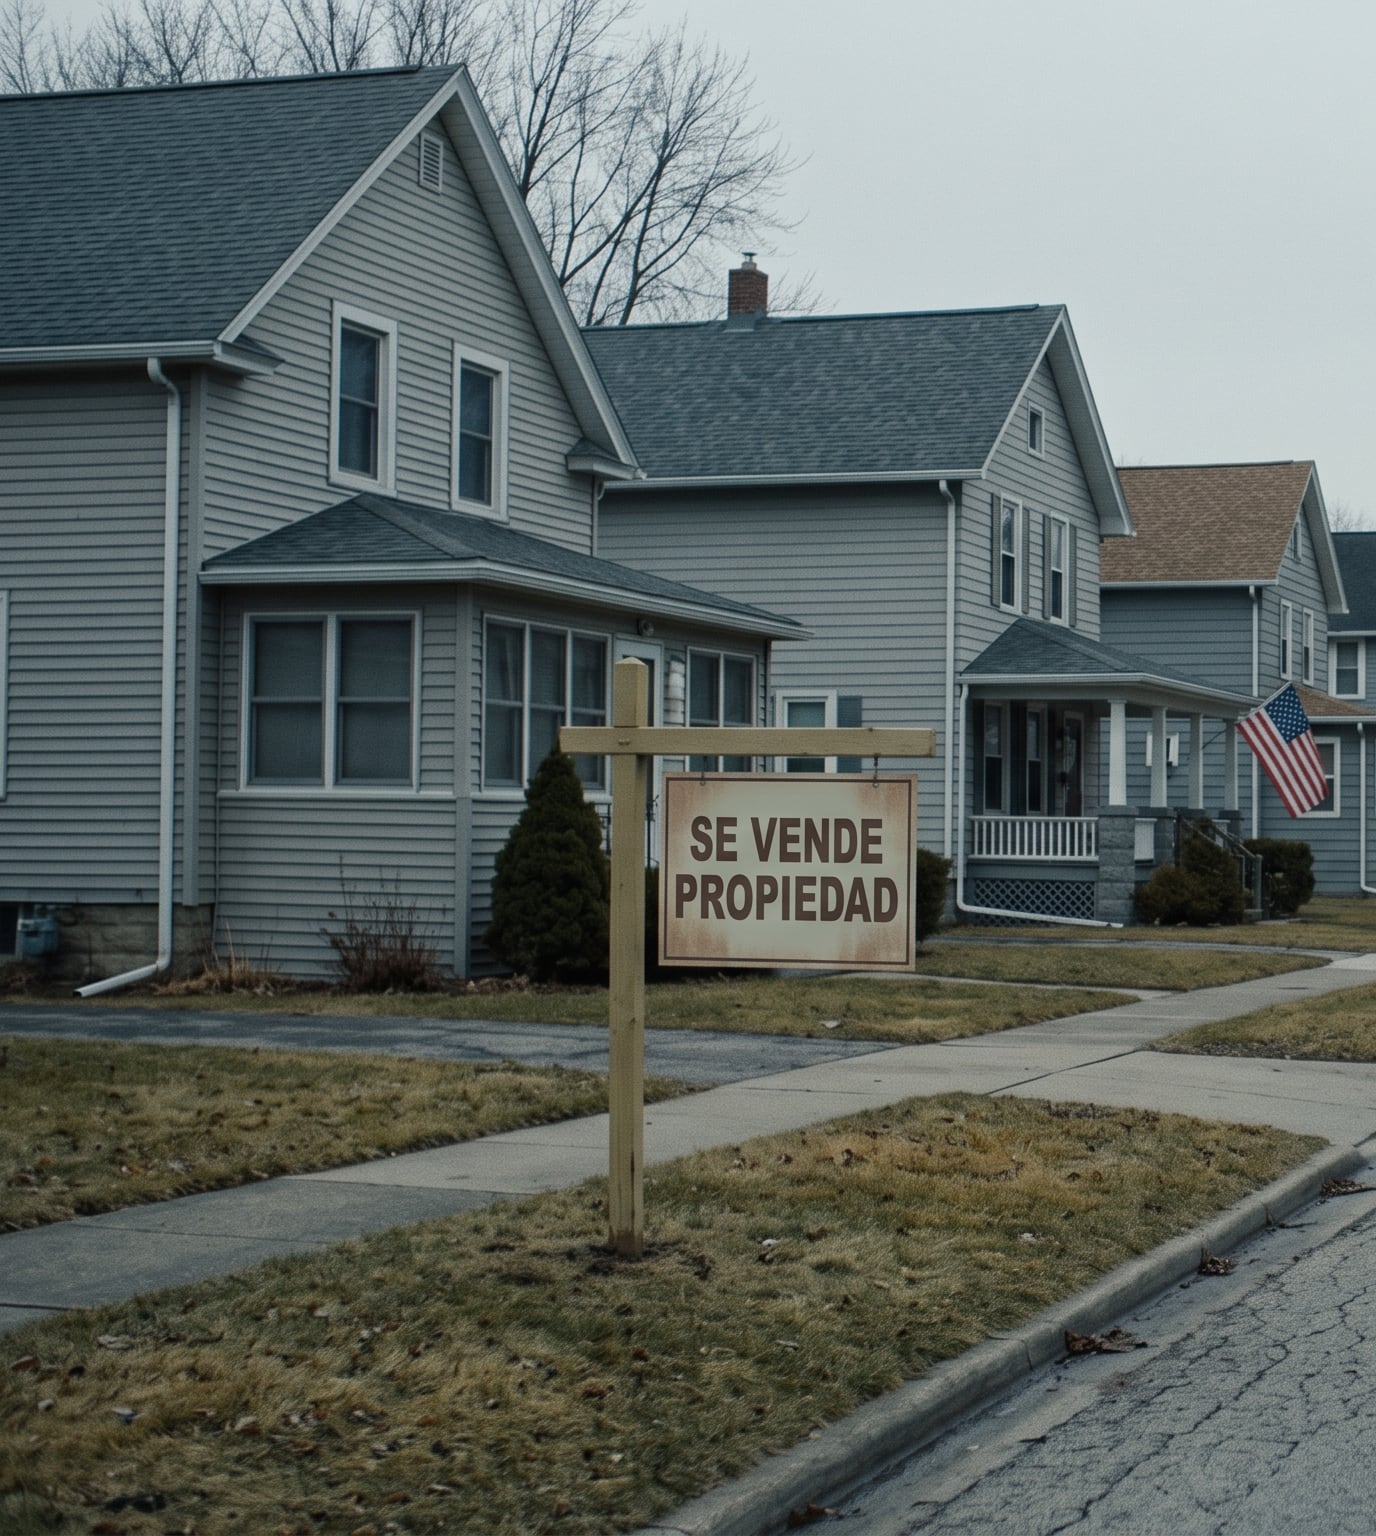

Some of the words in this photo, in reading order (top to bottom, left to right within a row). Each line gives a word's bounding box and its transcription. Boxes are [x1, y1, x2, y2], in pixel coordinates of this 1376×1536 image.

[689, 815, 738, 862] SE
[750, 816, 883, 864] VENDE
[675, 873, 899, 923] PROPIEDAD
